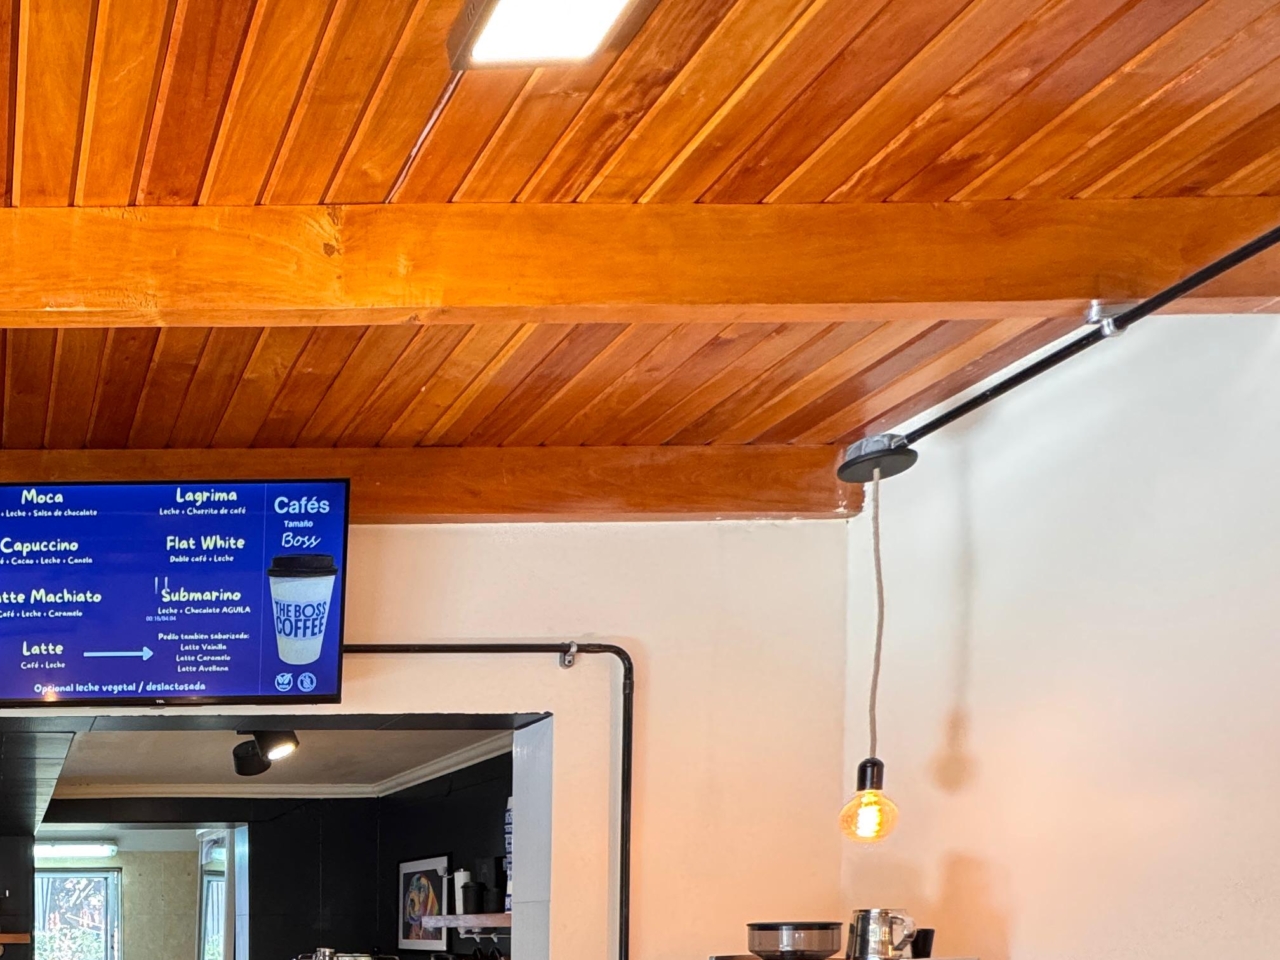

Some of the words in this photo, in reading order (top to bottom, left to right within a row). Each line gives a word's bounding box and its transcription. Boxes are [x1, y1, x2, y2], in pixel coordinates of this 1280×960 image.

[21, 488, 64, 505] Moca
[176, 487, 238, 506] Lagrima
[159, 507, 180, 515] Leche
[186, 507, 218, 515] Chorrito
[229, 506, 247, 514] café
[274, 496, 330, 514] Cafés
[5, 509, 26, 517] Leche
[33, 509, 53, 517] Salsa
[63, 508, 98, 516] chocolate
[283, 519, 314, 528] Tamaño
[166, 535, 196, 551] Flat
[200, 534, 245, 550] White
[281, 531, 322, 548] Boss
[0, 537, 79, 557] Capuccino
[11, 557, 34, 565] Cacao
[40, 556, 61, 565] Leche
[67, 556, 93, 564] Canela
[169, 555, 190, 563] Doble
[190, 554, 207, 562] café
[213, 554, 234, 562] Leche
[30, 588, 102, 604] Machiato
[161, 587, 241, 603] Submarino
[21, 609, 42, 617] Leche
[48, 609, 83, 617] Caramelo
[157, 607, 178, 615] Leche
[184, 606, 220, 615] Chocolate
[221, 606, 251, 614] AGUILA
[274, 600, 293, 618] THE
[294, 601, 327, 618] BOSS
[275, 615, 325, 638] COFFEE
[22, 640, 64, 656] Latte
[180, 643, 200, 651] Latte
[20, 661, 39, 669] Café
[45, 660, 66, 669] Leche
[175, 654, 195, 662] Latte
[196, 654, 231, 662] Caramelo
[177, 665, 197, 673] Latte
[33, 683, 74, 695] Opcional
[75, 682, 99, 693] leche
[101, 682, 136, 694] vegetal
[146, 681, 206, 692] deslactosada
